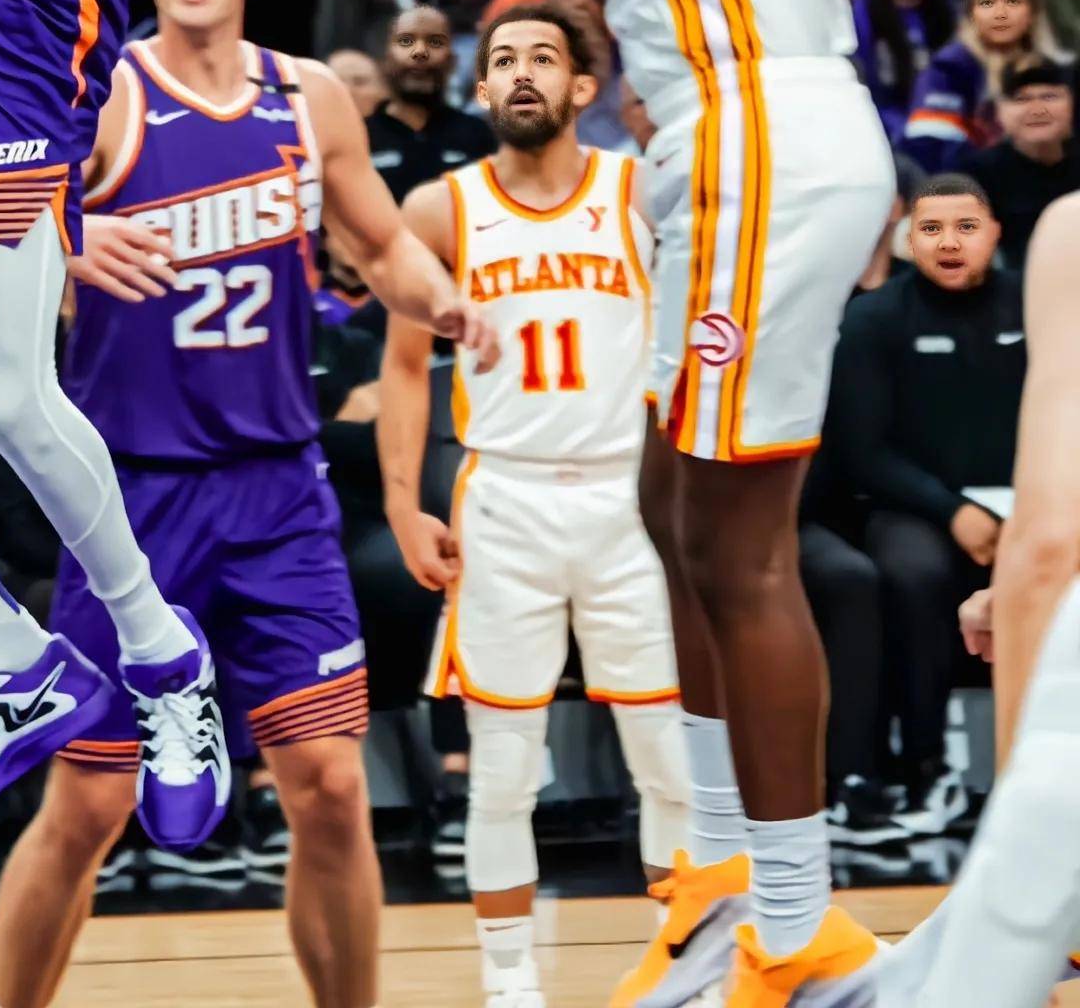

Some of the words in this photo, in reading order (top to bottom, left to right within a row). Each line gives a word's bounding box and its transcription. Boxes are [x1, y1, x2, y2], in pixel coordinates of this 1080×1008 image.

[172, 263, 274, 349] 22
[471, 252, 631, 303] ATLANTA
[519, 318, 587, 392] 11
